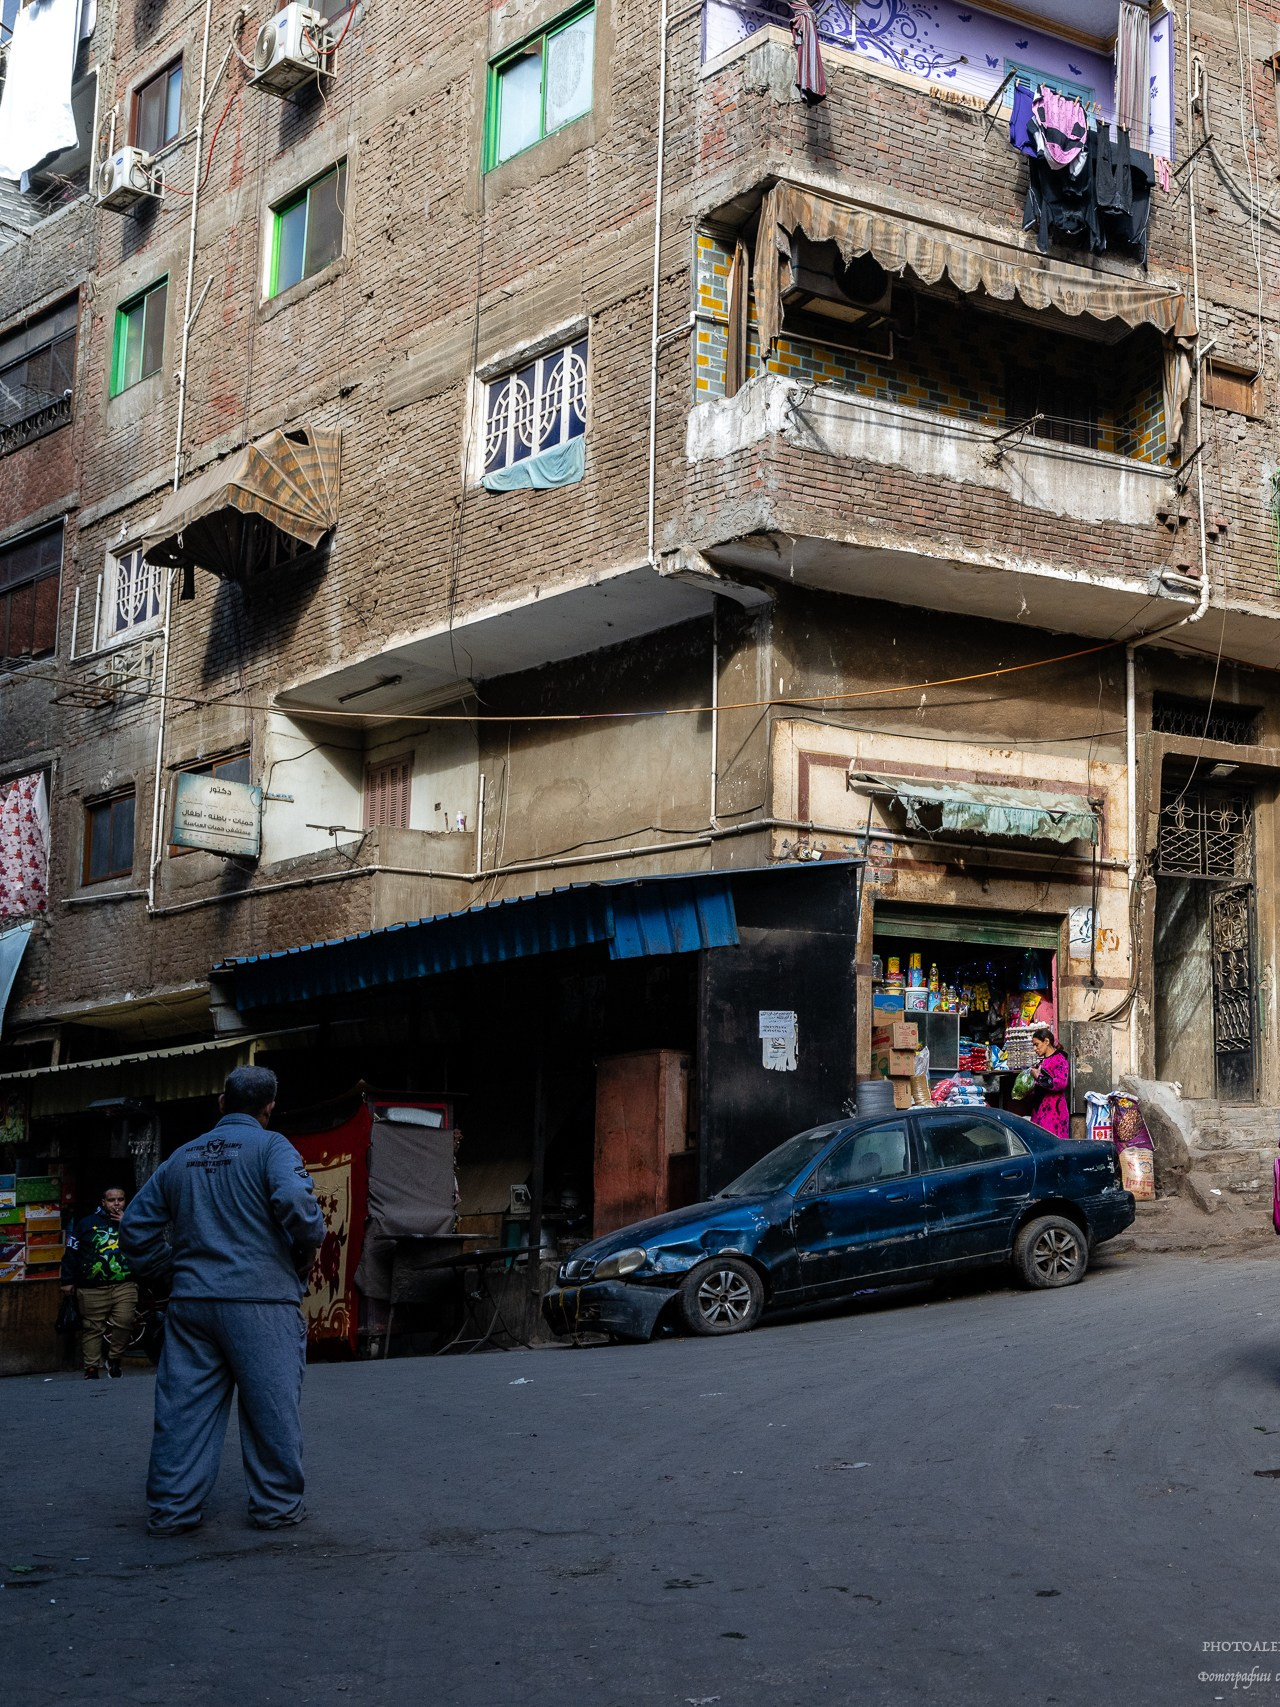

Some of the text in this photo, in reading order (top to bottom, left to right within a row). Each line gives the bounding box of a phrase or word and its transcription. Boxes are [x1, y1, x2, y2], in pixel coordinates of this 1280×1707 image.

[209, 786, 232, 796] دكتور
[181, 809, 203, 819] أطفال
[232, 817, 254, 827] حميات
[207, 824, 225, 832] حميات
[225, 826, 251, 836] مستشفى
